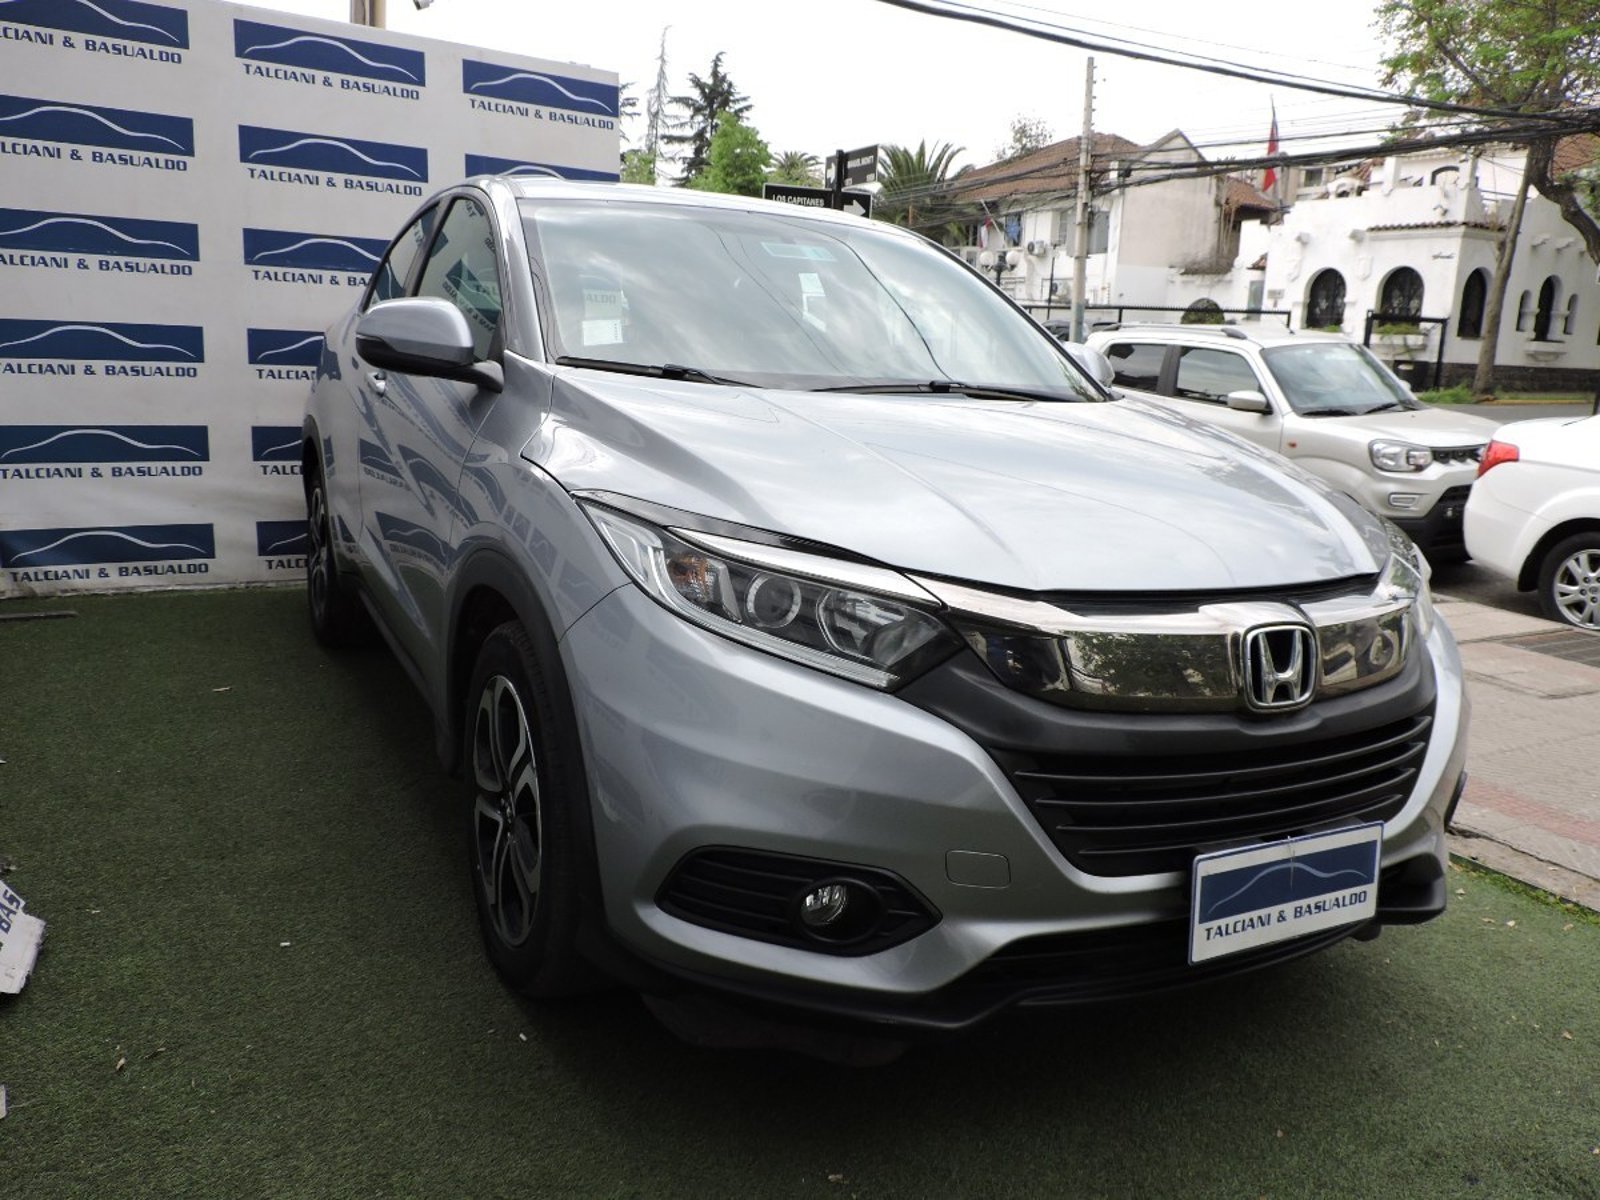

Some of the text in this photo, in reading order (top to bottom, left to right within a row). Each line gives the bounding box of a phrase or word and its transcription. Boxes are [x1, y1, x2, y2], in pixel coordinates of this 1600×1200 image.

[62, 36, 75, 48] &
[85, 39, 182, 64] BASUALDO
[244, 63, 419, 100] TALCIANI & BASUALDO
[469, 98, 614, 130] TALCIANI & BASUALDO
[70, 150, 82, 160] &
[92, 151, 187, 171] BASUALDO
[248, 168, 422, 197] TALCIANI & BASUALDO
[77, 259, 89, 270] &
[99, 260, 192, 276] BASUALDO
[252, 270, 322, 284] TALCIANI
[330, 276, 339, 285] &
[0, 363, 197, 377] ALCIANI & BASUALDO
[0, 466, 202, 479] TALCIANI & BASUALDO
[10, 563, 208, 583] TALCIANI & BASUALDO
[1205, 891, 1367, 940] TALCIANI & BASUALDO
